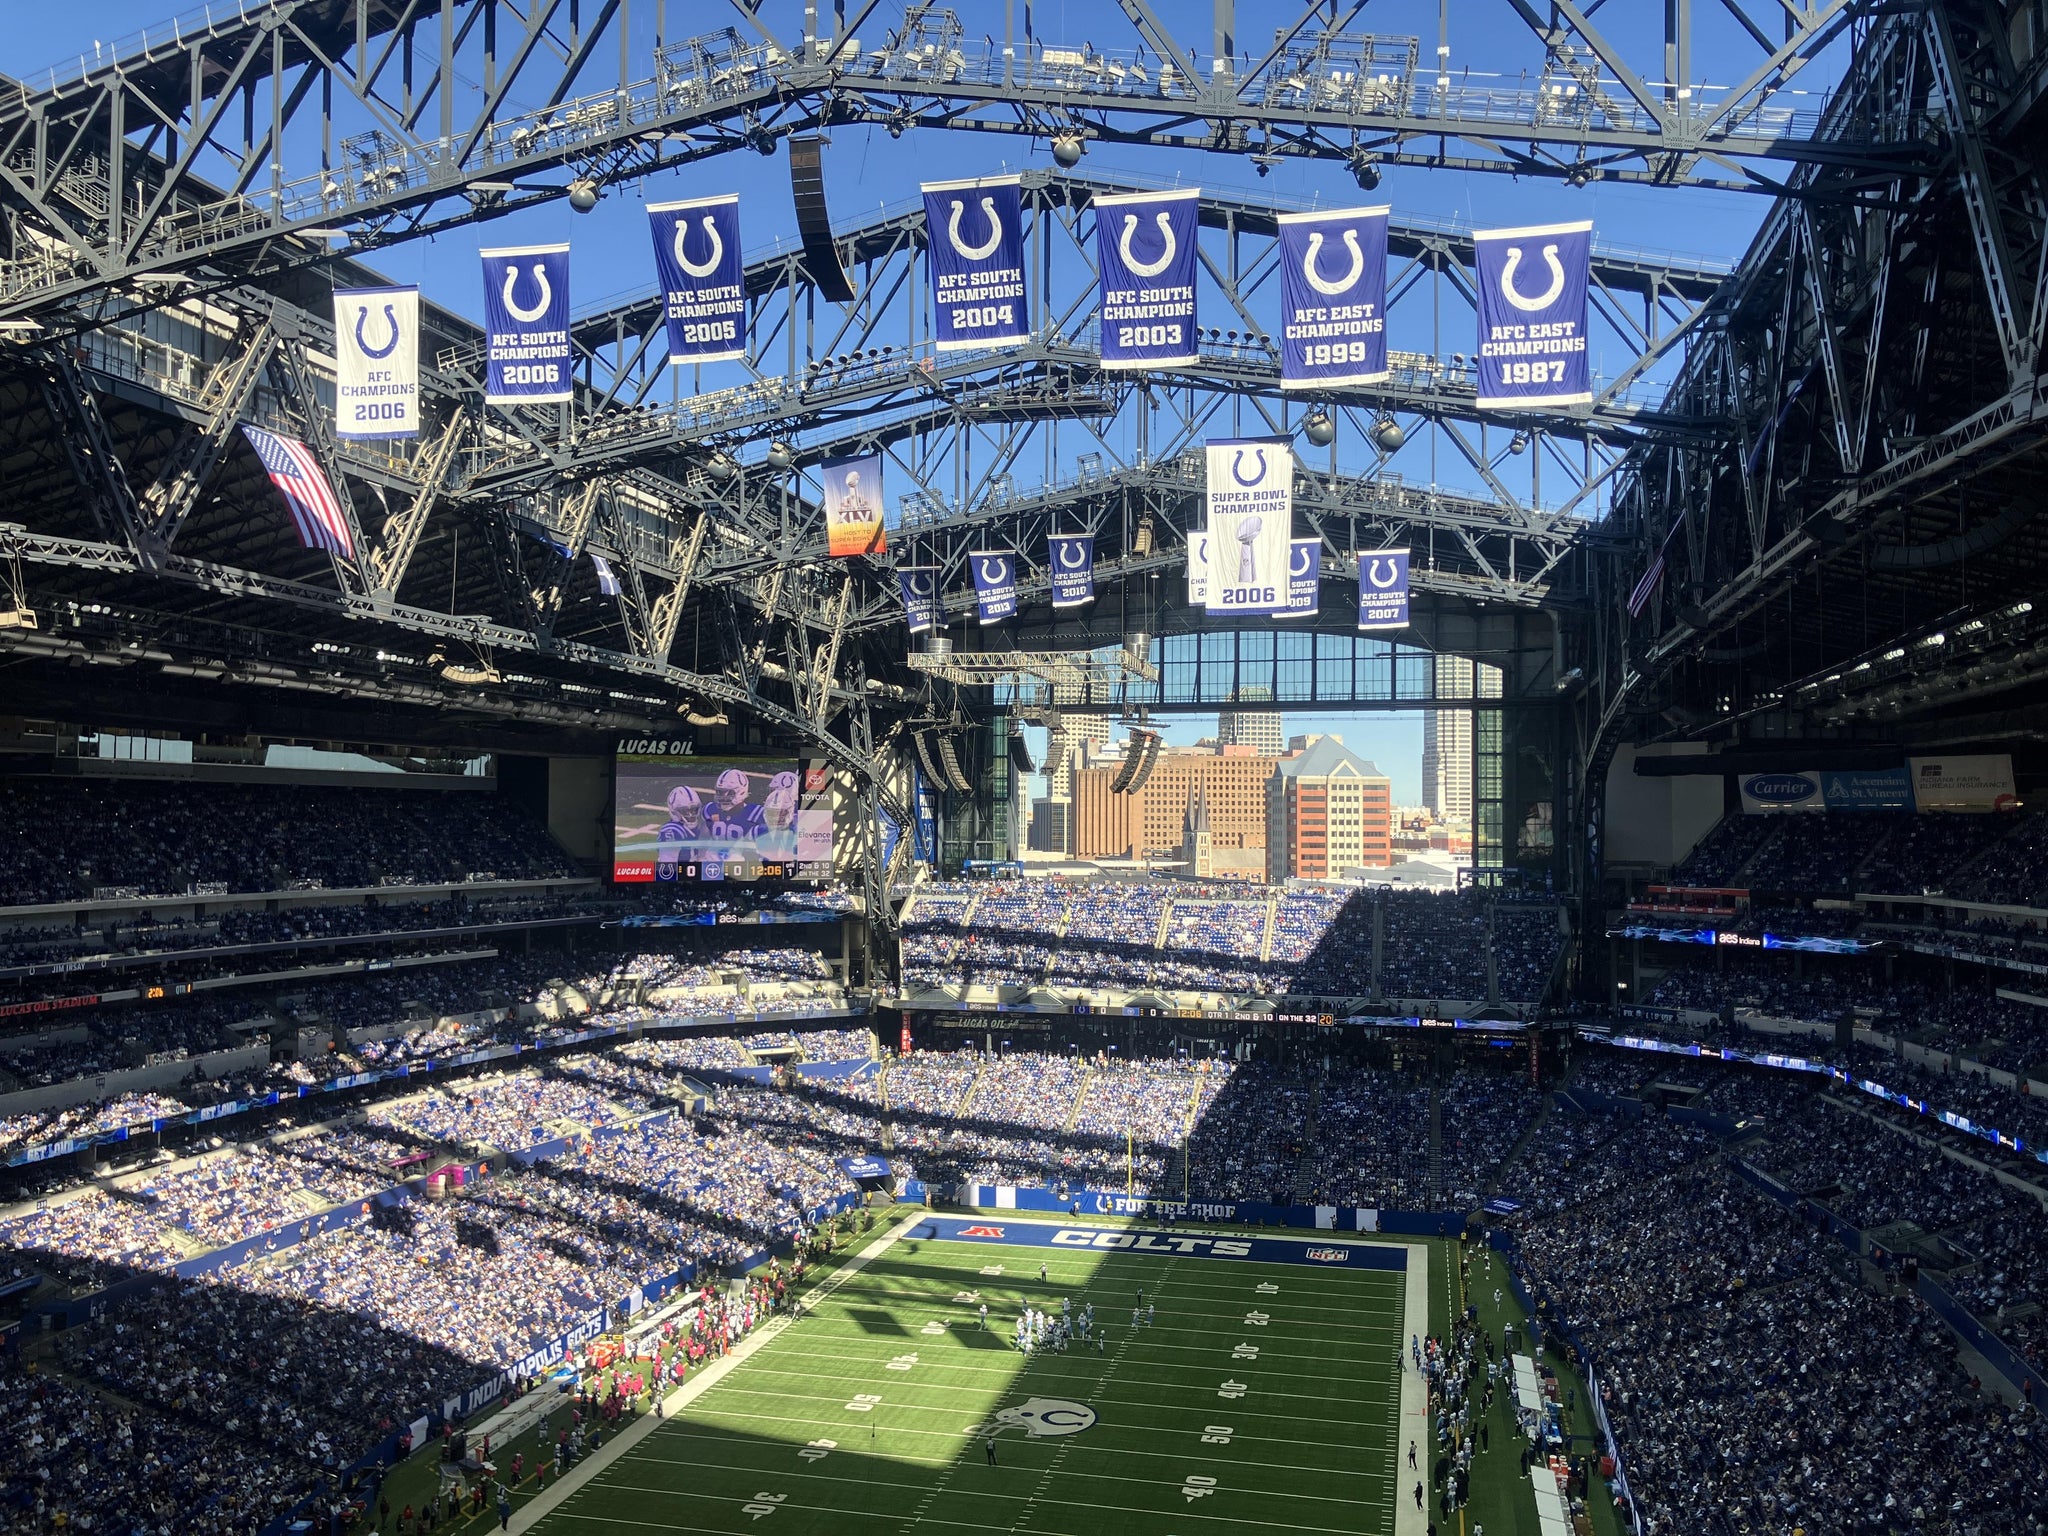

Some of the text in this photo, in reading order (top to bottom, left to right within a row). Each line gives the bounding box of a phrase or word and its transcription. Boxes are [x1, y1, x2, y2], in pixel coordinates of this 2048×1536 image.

[939, 268, 1020, 288] AFC SOUTH
[668, 285, 741, 304] AFC SOUTH
[937, 282, 1024, 304] CHAMPIONS
[1106, 286, 1192, 304] AFC SOUTH
[668, 300, 744, 318] CHAMPIONS
[952, 304, 1013, 328] 2004
[1104, 302, 1193, 320] CHAMPIONS
[1294, 304, 1374, 322] AFC EAST
[684, 320, 736, 344] 2005
[1119, 325, 1182, 347] 2003
[1286, 319, 1382, 340] CHAMPIONS
[1492, 322, 1576, 340] AFC EAST
[492, 331, 566, 346] AFC SOUTH
[490, 344, 568, 360] CHAMPIONS
[1304, 342, 1366, 366] 1999
[1482, 338, 1585, 356] CHAMPIONS
[367, 371, 391, 382] AFC
[504, 365, 558, 384] 2006
[1502, 361, 1566, 384] 1987
[342, 383, 416, 396] CHAMPIONS
[355, 402, 405, 421] 2006
[1212, 490, 1288, 502] SUPER BOWL
[1214, 502, 1286, 514] CHAMPIONS
[838, 511, 873, 524] XLV
[1054, 576, 1092, 586] CHAMPIONS
[1069, 570, 1090, 578] SOUTH
[992, 586, 1014, 595] SOUTH
[1062, 586, 1086, 597] 2010
[1291, 580, 1316, 588] SOUTH
[980, 592, 1016, 604] CHAMPIONS
[1222, 587, 1275, 604] 2006
[1290, 597, 1311, 607] 009
[988, 602, 1010, 614] 2013
[1368, 608, 1399, 619] 2007
[617, 740, 694, 755] LUCAS OIL
[1754, 781, 1806, 796] Carrier
[1850, 776, 1906, 786] Ascension
[1920, 782, 1954, 790] BUREAU
[1867, 788, 1908, 798] Vincent
[616, 868, 638, 876] LUCAS
[686, 865, 696, 877] 0
[734, 865, 742, 876] 0
[750, 865, 782, 876] 12:06
[720, 914, 737, 924] aes
[1719, 933, 1761, 946] aes Indiana
[52, 963, 86, 973] JIM IRSAY
[0, 996, 99, 1017] LUCAS OIL STADIUM
[958, 1019, 988, 1028] LUCAS
[991, 1020, 1005, 1028] OIL
[1320, 1015, 1332, 1024] 20
[1116, 1198, 1146, 1212] FOR
[1052, 1230, 1252, 1256] COLTS
[1312, 1252, 1344, 1261] NFL
[1255, 1284, 1280, 1294] 10
[1244, 1313, 1270, 1325] 20
[566, 1314, 602, 1349] COLTS
[1231, 1345, 1260, 1360] 30
[1217, 1382, 1248, 1399] 40
[844, 1394, 882, 1412] 50
[1200, 1425, 1234, 1444] 50
[797, 1439, 839, 1459] 40
[1182, 1475, 1217, 1498] 40
[741, 1492, 788, 1516] 30
